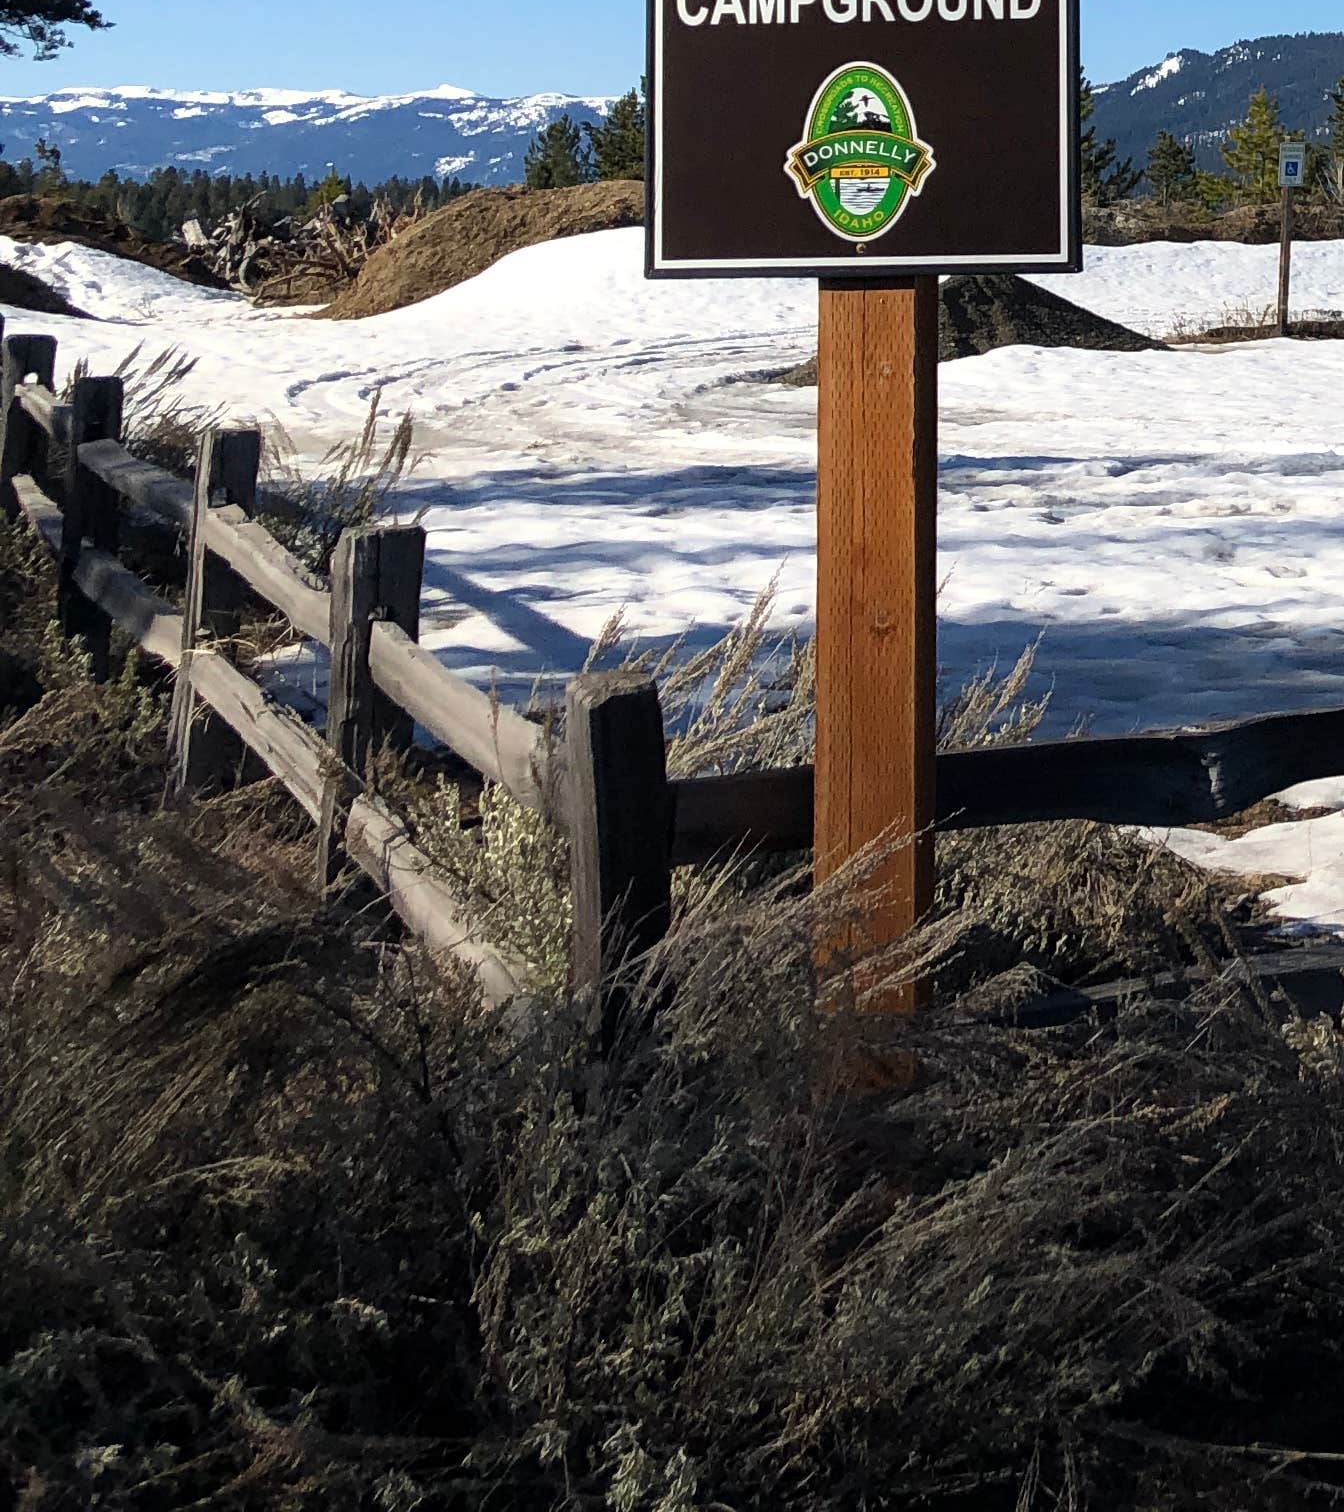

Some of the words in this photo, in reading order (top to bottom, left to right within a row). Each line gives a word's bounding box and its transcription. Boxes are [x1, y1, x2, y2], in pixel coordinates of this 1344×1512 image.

[854, 75, 869, 83] TO
[802, 140, 917, 168] DONNELLY
[860, 168, 880, 176] 1914
[833, 209, 884, 229] IDAHO
